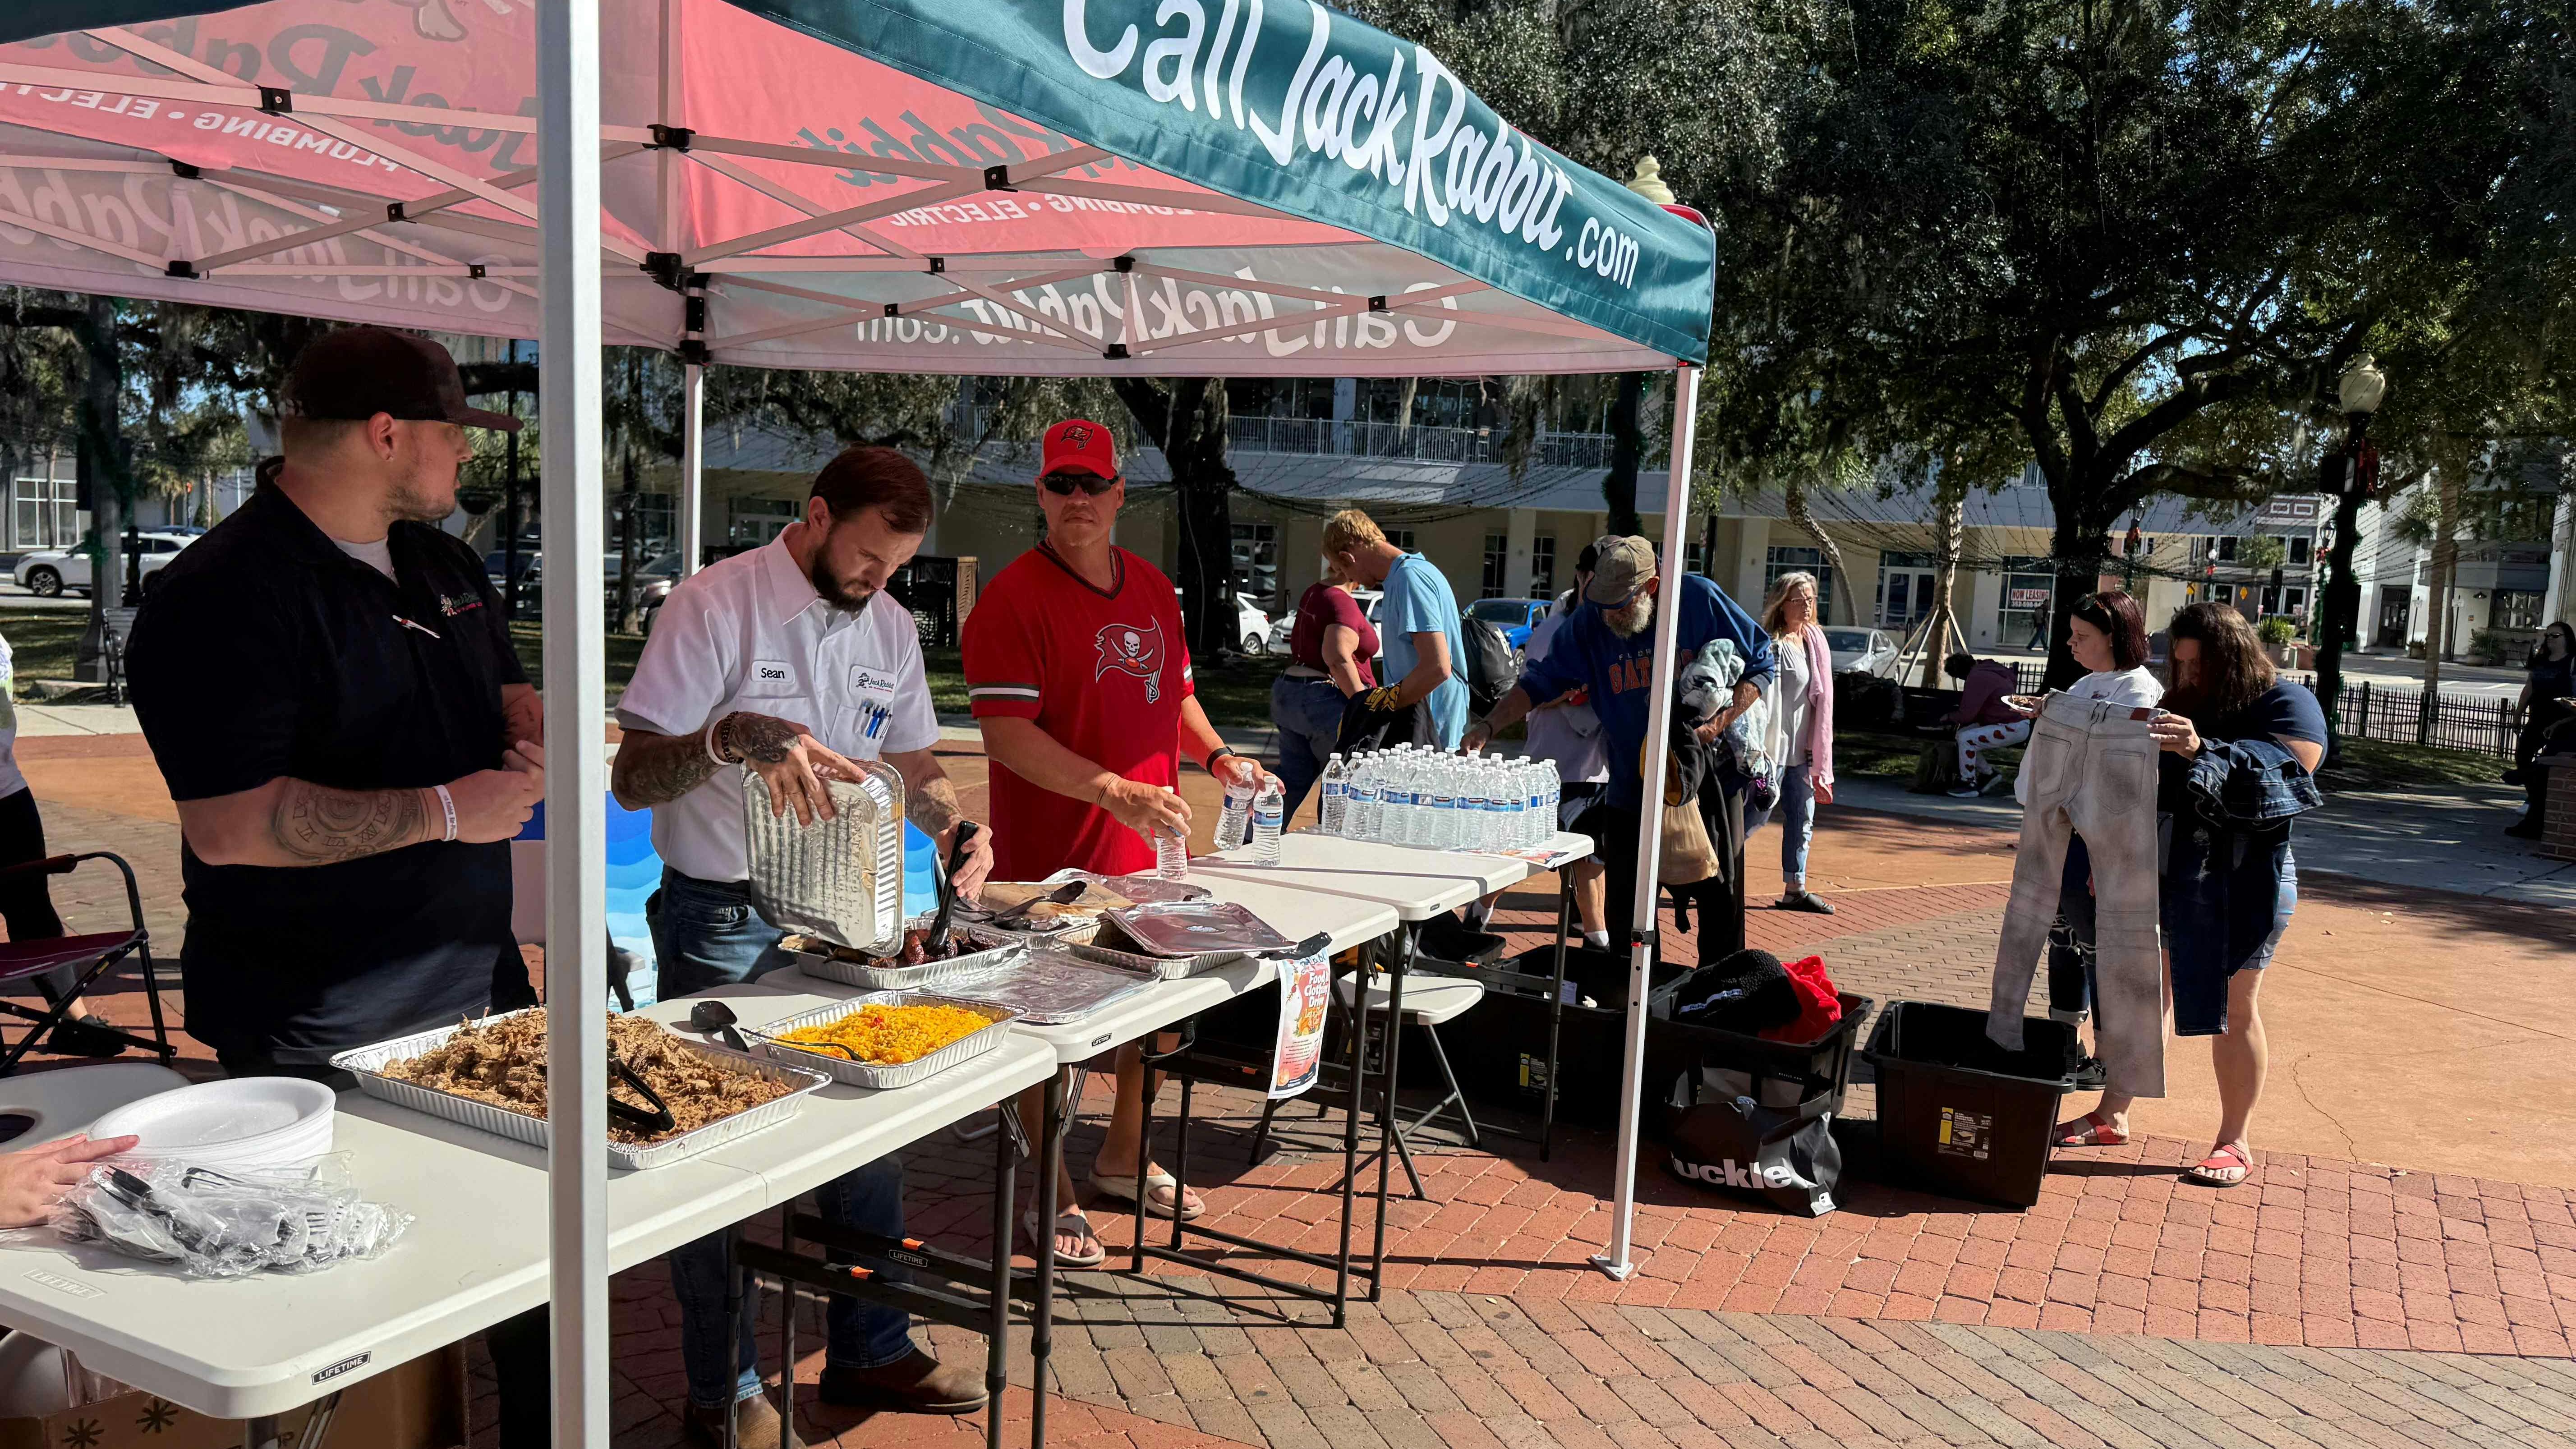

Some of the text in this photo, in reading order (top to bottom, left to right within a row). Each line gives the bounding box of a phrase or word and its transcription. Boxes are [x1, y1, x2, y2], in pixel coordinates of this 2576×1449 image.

[2013, 590, 2024, 599] NOW
[761, 667, 785, 679] Sean
[1671, 1151, 1792, 1189] uckle
[893, 1251, 923, 1265] LIFETIME
[319, 1357, 363, 1380] LIFETIME
